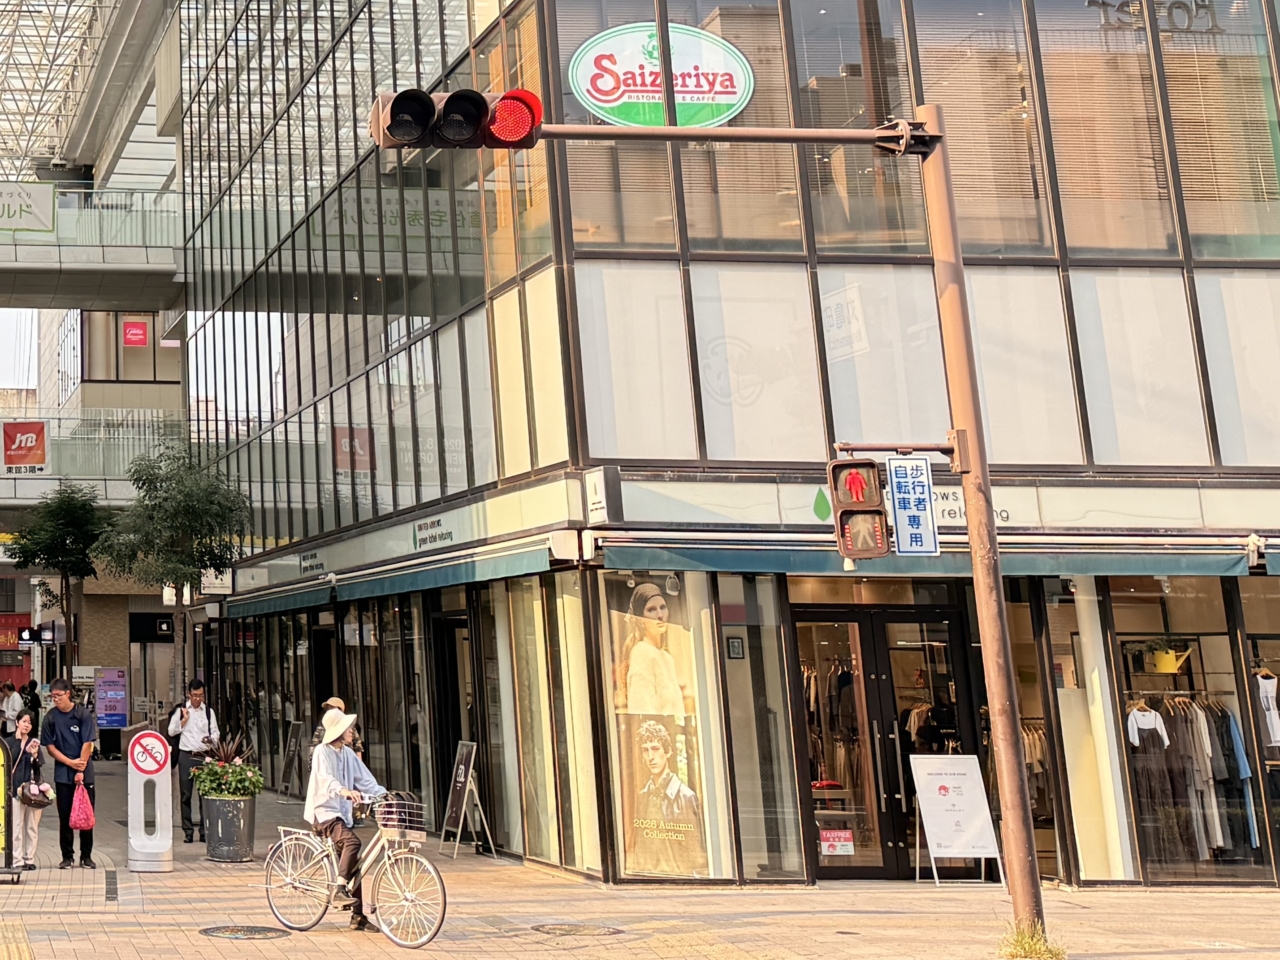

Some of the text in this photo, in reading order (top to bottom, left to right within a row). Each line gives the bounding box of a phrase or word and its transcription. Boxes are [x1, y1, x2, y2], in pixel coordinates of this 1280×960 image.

[12, 433, 37, 449] JTB
[893, 465, 913, 511] 自転車
[909, 464, 928, 512] 歩行者
[907, 514, 924, 548] 専用
[633, 819, 694, 831] 2026 Autumn
[644, 829, 685, 840] Collection
